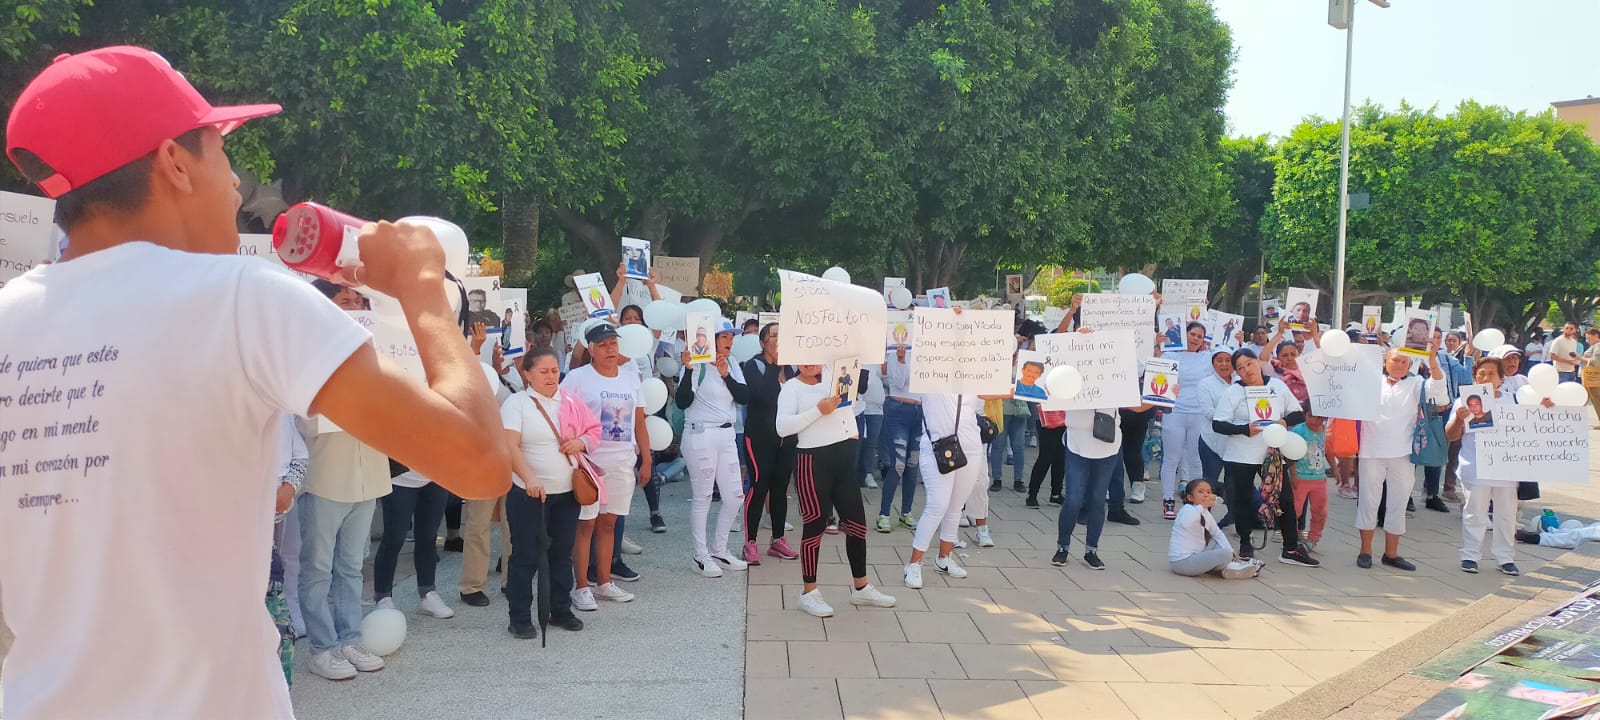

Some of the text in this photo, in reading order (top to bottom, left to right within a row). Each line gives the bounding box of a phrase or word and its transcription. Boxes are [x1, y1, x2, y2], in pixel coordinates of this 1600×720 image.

[917, 316, 932, 337] Yo
[937, 321, 952, 330] no
[940, 340, 976, 350] esposa
[979, 337, 992, 346] de
[993, 338, 1005, 346] un
[17, 356, 58, 381] quiera
[62, 353, 83, 376] que
[86, 345, 119, 364] estés
[916, 354, 954, 364] esposo
[957, 356, 977, 364] con
[932, 369, 949, 384] hay
[18, 385, 63, 407] decirte
[66, 386, 87, 410] que
[92, 380, 105, 398] te
[1526, 407, 1583, 422] Marcha
[21, 427, 39, 441] en
[43, 421, 59, 439] mi
[61, 415, 100, 436] mente
[1505, 425, 1527, 438] por
[1483, 435, 1590, 449] nuestros muertos
[11, 458, 29, 476] mi
[34, 454, 79, 474] corazón
[83, 453, 110, 478] por
[1502, 449, 1581, 467] desaparecidos
